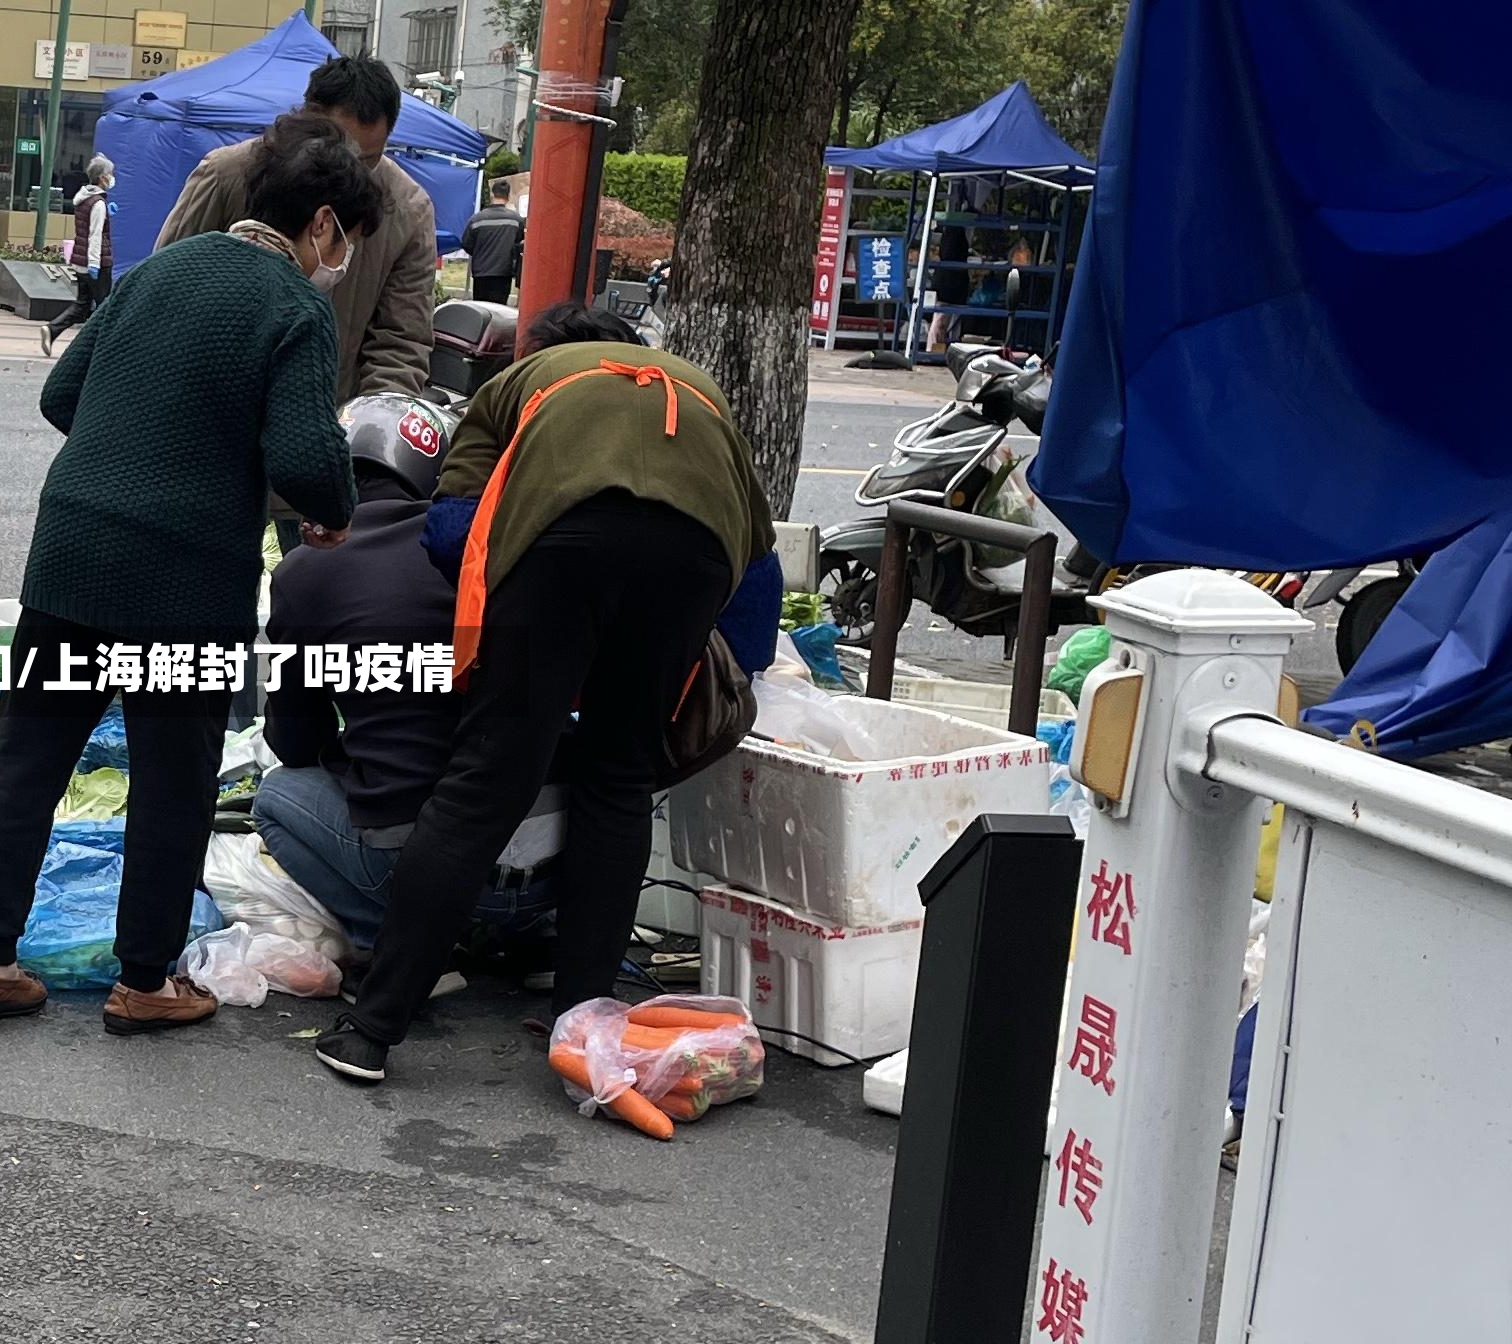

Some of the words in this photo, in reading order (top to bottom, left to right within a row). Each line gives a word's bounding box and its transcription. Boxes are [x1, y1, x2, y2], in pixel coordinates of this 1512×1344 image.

[42, 46, 85, 57] 文小区
[142, 51, 163, 65] 59
[872, 237, 891, 301] 检查点
[409, 417, 434, 446] 66
